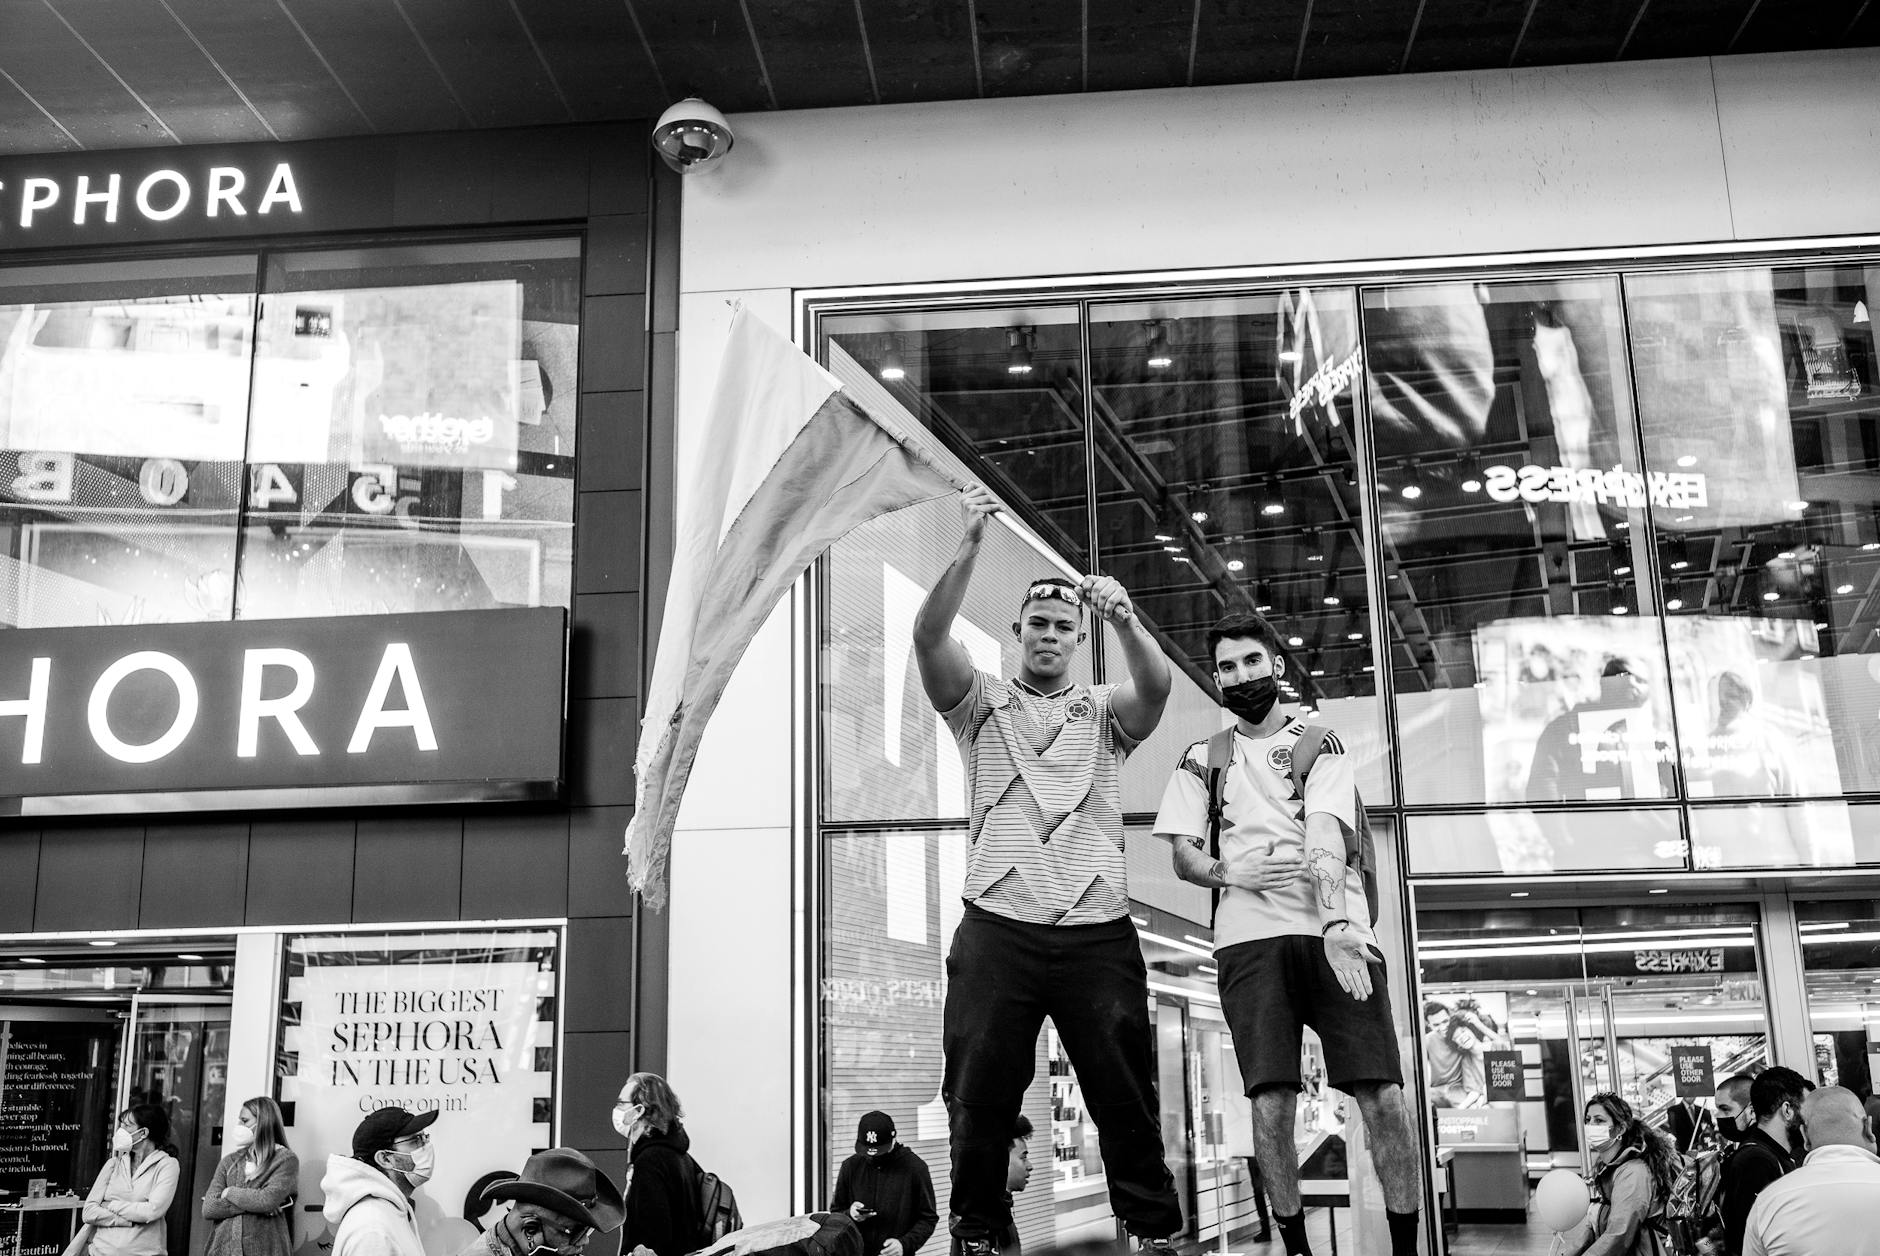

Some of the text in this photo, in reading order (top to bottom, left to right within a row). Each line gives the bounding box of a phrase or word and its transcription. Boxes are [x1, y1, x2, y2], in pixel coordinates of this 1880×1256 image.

[0, 163, 303, 228] PHORA
[335, 989, 504, 1014] THE BIGGEST
[331, 1020, 503, 1052] SEPHORA
[39, 1041, 47, 1050] in
[26, 1051, 36, 1060] all
[1679, 1055, 1704, 1063] PLEASE
[1490, 1060, 1515, 1068] PLEASE
[1680, 1062, 1694, 1070] USE
[24, 1071, 58, 1081] fearlessly
[60, 1071, 94, 1081] together
[332, 1057, 502, 1086] IN THE USA
[1492, 1073, 1515, 1081] OTHER
[1681, 1075, 1702, 1083] DOOR
[16, 1083, 29, 1091] our
[1493, 1080, 1513, 1088] DOOR
[359, 1093, 468, 1113] Come on in!
[20, 1113, 38, 1122] stop
[55, 1122, 80, 1131] where
